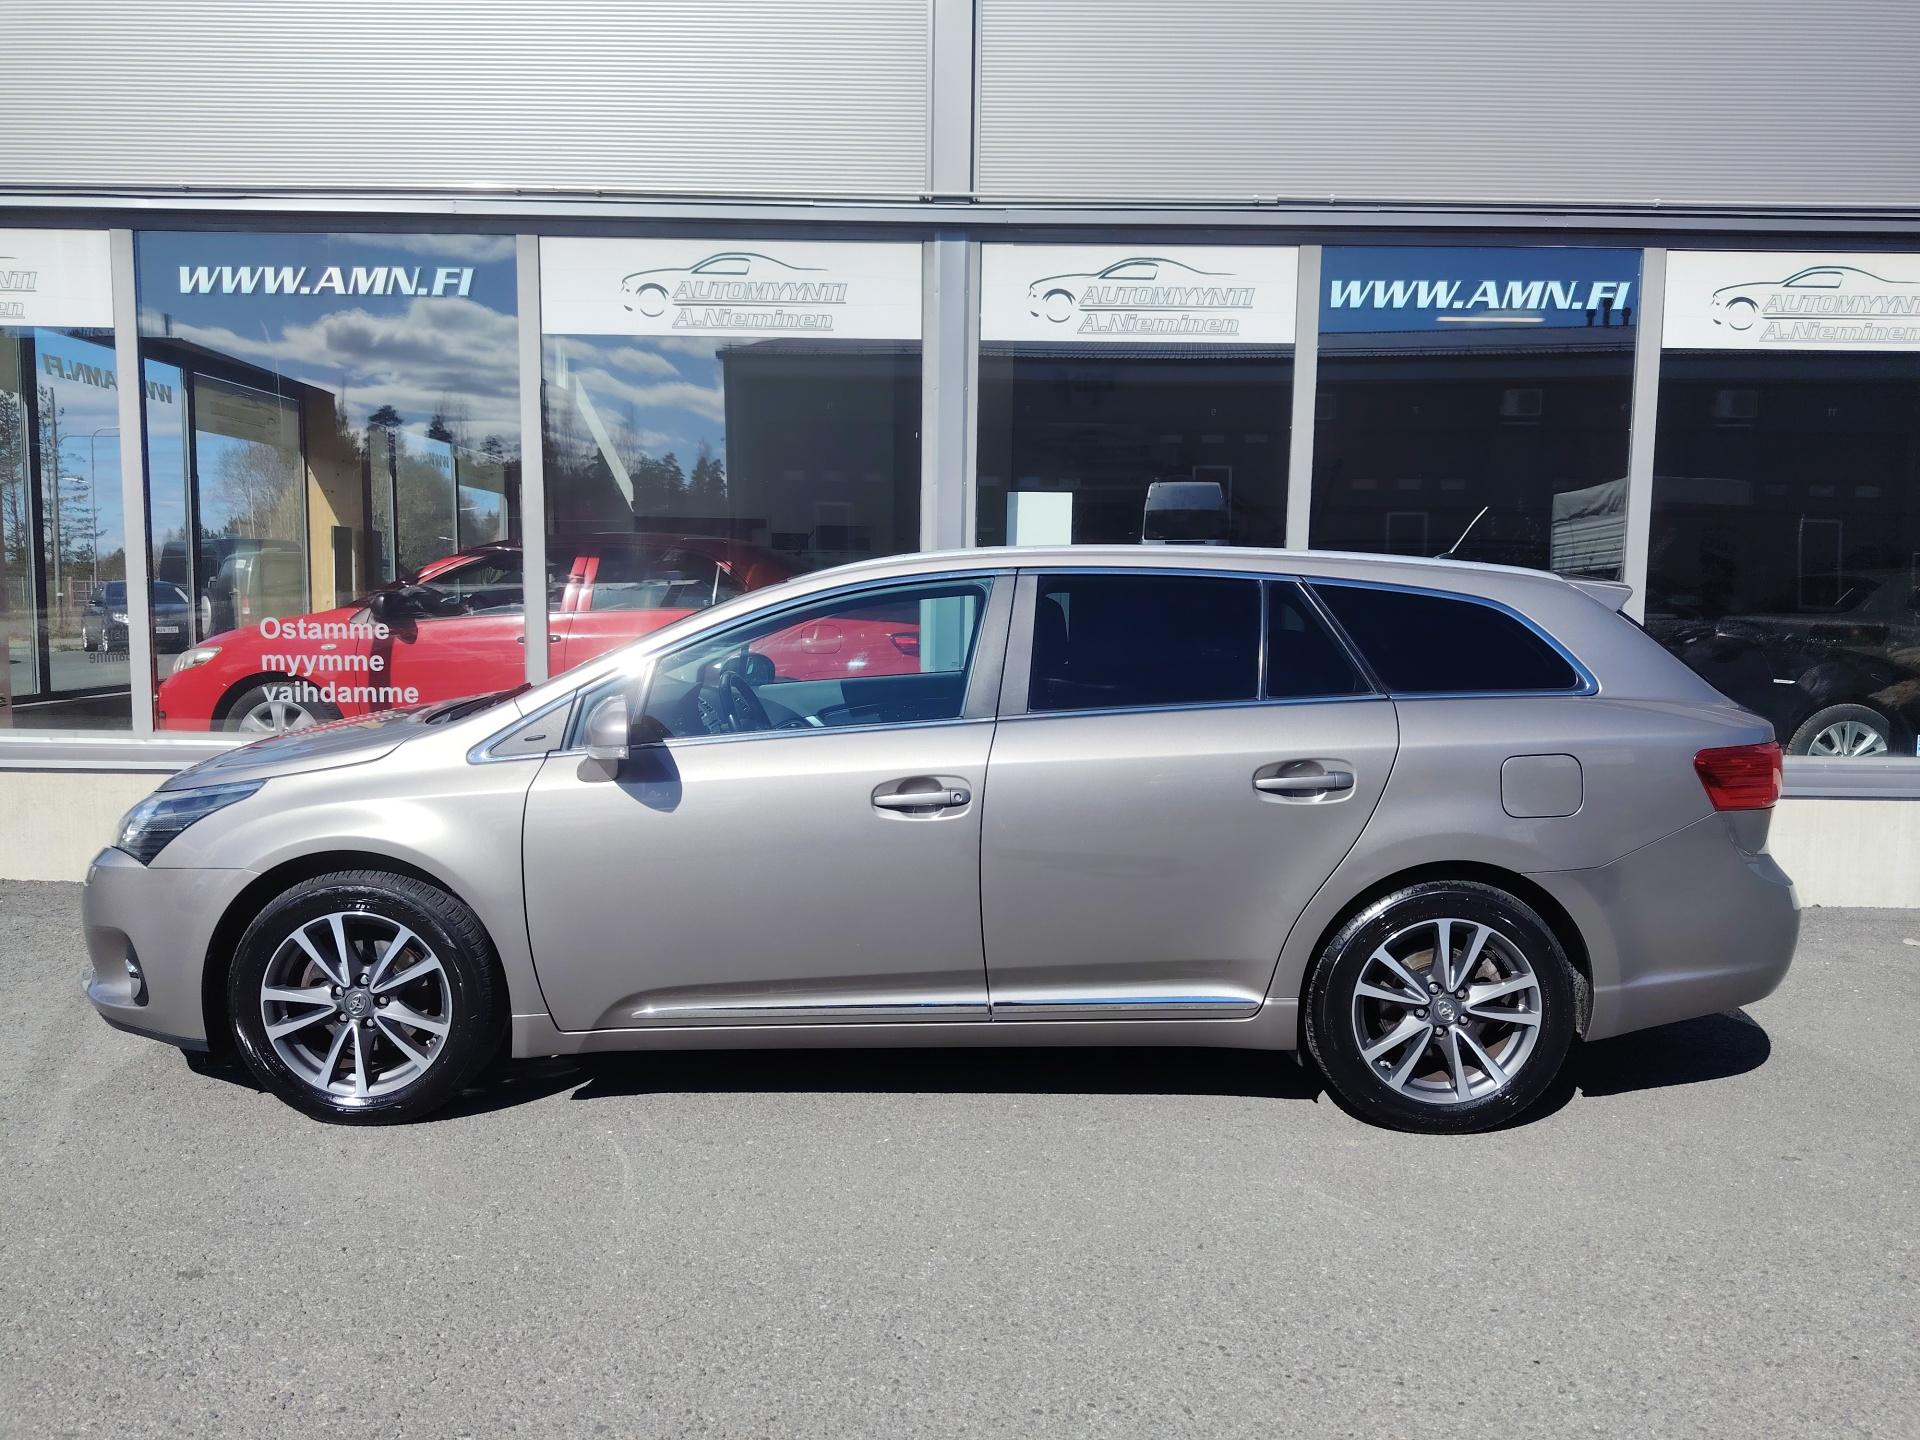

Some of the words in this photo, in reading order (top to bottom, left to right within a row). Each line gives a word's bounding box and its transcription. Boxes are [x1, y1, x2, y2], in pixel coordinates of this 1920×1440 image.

[179, 266, 475, 296] WWW.AMN.FI
[672, 280, 848, 302] AUTOMYYNTI
[1079, 286, 1255, 306] AUTOMYYNTI
[1330, 279, 1632, 310] WWW.AMN.FI
[672, 308, 833, 329] A.Nieminen
[1078, 313, 1240, 334] A.Nieminen
[260, 617, 390, 640] Ostamme
[261, 653, 385, 676] myymme
[262, 681, 419, 703] vaihdamme
